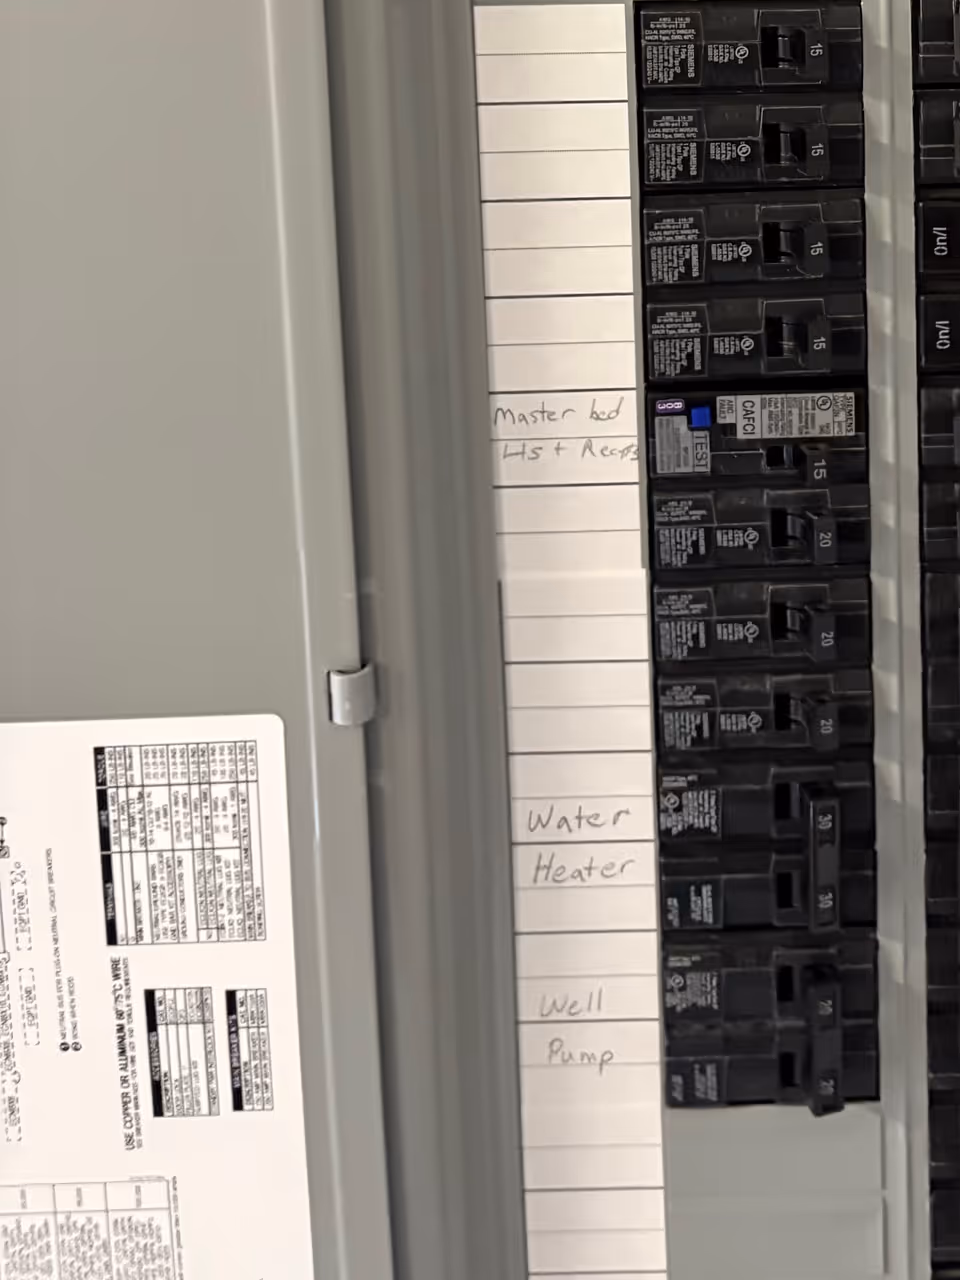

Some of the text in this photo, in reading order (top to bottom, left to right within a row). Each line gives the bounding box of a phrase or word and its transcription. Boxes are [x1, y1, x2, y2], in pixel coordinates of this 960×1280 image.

[810, 43, 823, 57] 15
[812, 143, 824, 156] 15
[810, 242, 824, 256] 15
[813, 336, 826, 351] 15
[494, 396, 625, 426] Master bed
[741, 400, 756, 435] CAFCI
[846, 396, 854, 434] SIEMENS
[695, 434, 709, 469] TEST
[813, 458, 827, 480] 15
[819, 532, 832, 548] 20
[820, 631, 834, 648] 20
[820, 718, 833, 734] 20
[528, 804, 632, 833] Water
[533, 851, 635, 885] Heater
[540, 987, 602, 1017] Well
[115, 1023, 129, 1073] ALUMINUM
[548, 1037, 614, 1077] Pump
[120, 1091, 135, 1130] COPPER
[124, 1132, 136, 1151] USE
